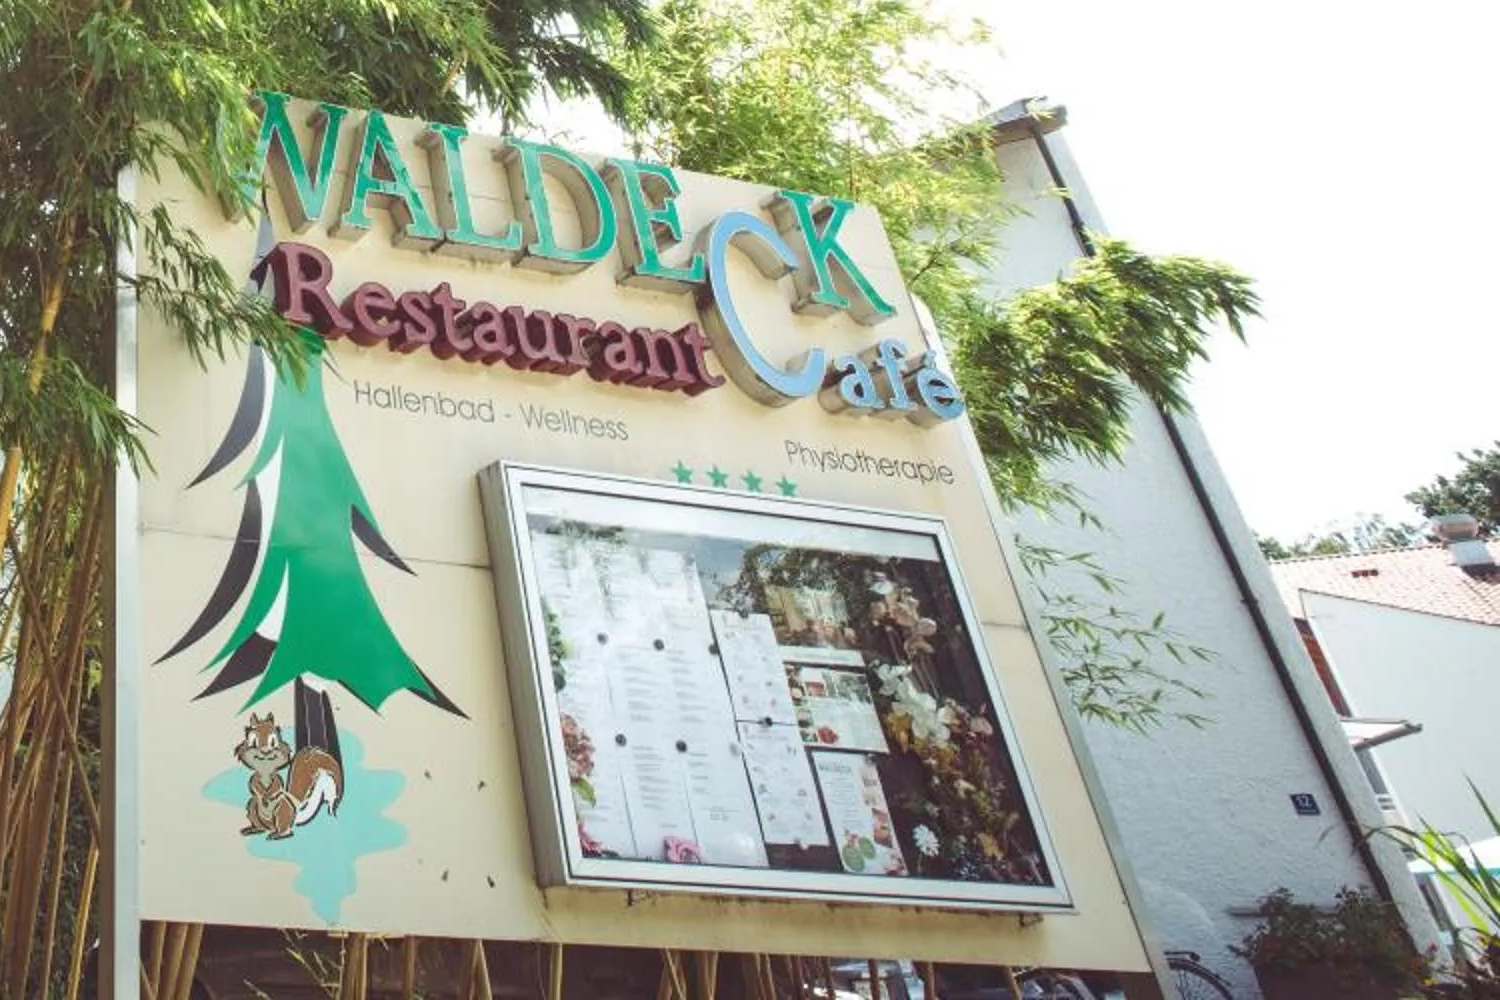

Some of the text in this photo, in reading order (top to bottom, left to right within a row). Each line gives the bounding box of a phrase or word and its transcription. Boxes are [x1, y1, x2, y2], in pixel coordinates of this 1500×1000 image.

[271, 242, 726, 388] Restaurant
[353, 379, 495, 423] Hallenbad
[519, 403, 629, 441] Wellness
[784, 439, 955, 485] Physiotherapie
